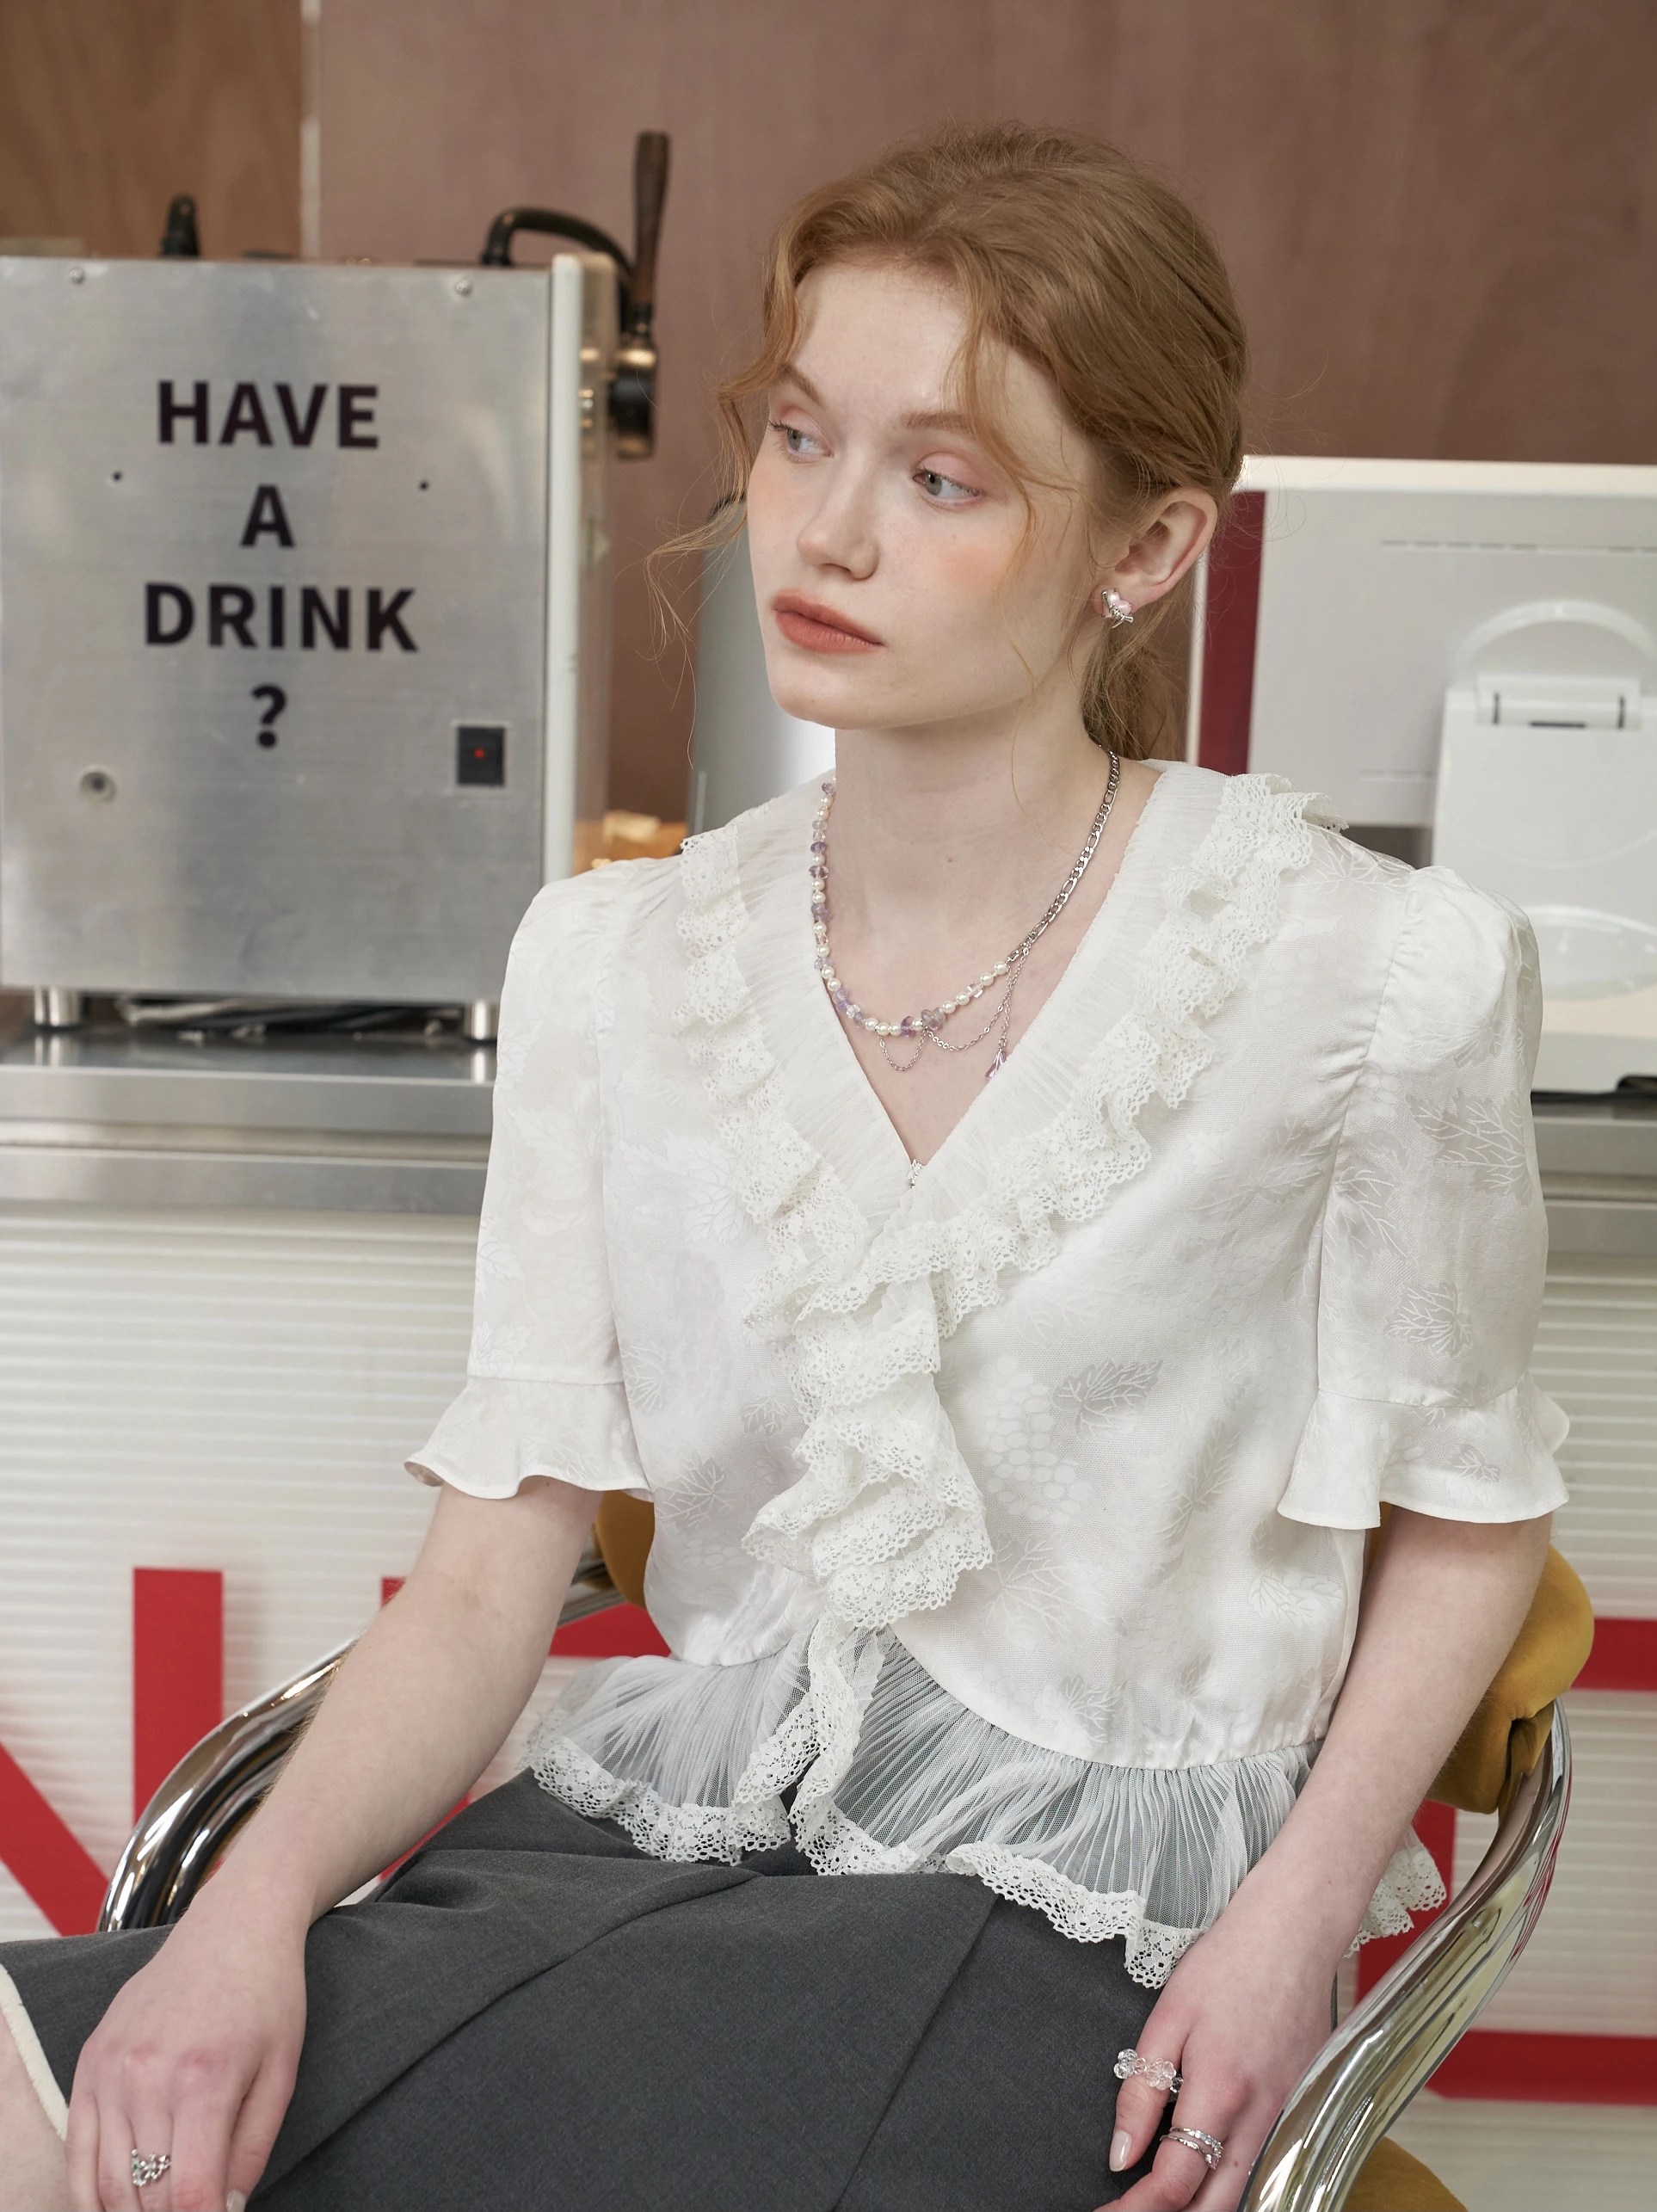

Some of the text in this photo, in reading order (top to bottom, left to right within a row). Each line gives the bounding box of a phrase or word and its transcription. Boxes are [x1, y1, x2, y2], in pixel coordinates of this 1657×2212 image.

[157, 379, 379, 450] HAVE
[238, 484, 297, 549] A
[144, 582, 419, 653] DRINK
[249, 682, 288, 749] ?
